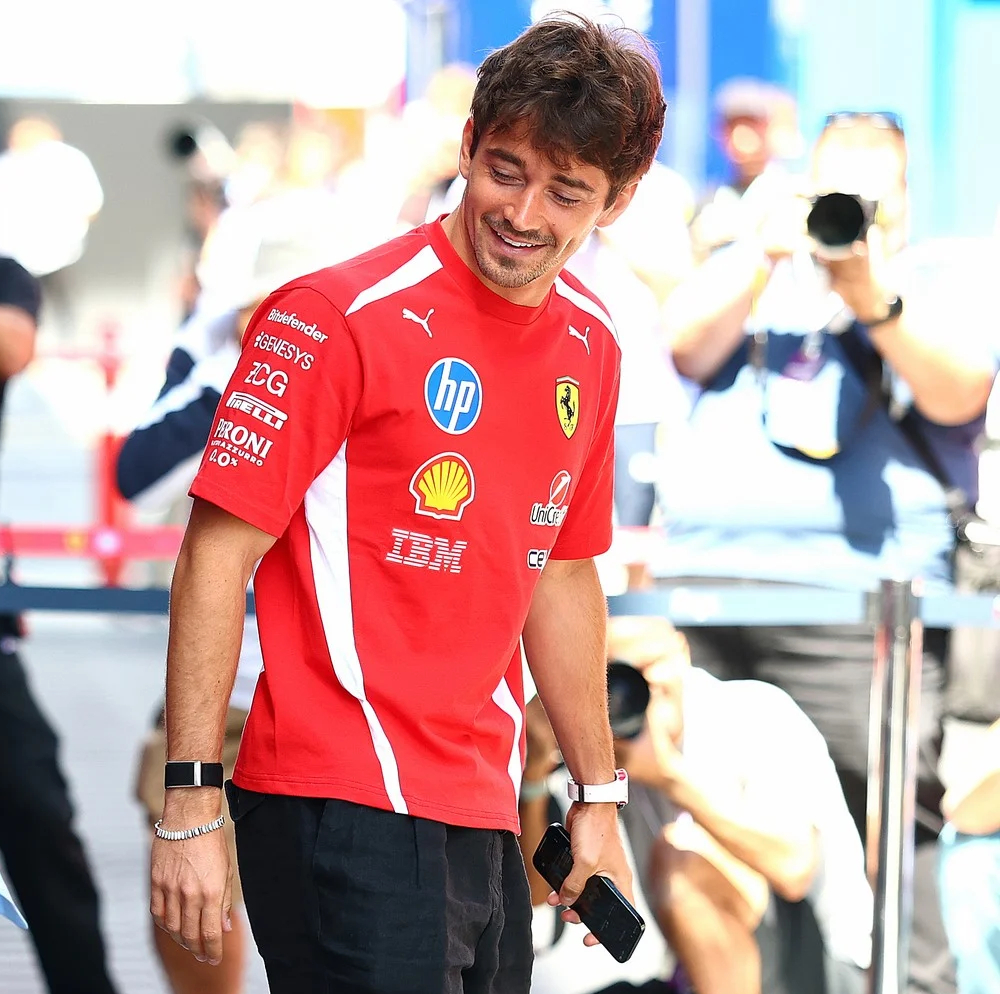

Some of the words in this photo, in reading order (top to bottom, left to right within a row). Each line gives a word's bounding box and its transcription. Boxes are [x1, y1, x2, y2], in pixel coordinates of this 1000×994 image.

[267, 308, 328, 343] Bitdefender
[259, 333, 315, 370] GENESYS
[226, 391, 288, 430] PIRELLI
[433, 358, 476, 433] hp
[214, 418, 273, 459] PERONI
[531, 504, 566, 525] UniCre
[386, 528, 468, 573] IBM
